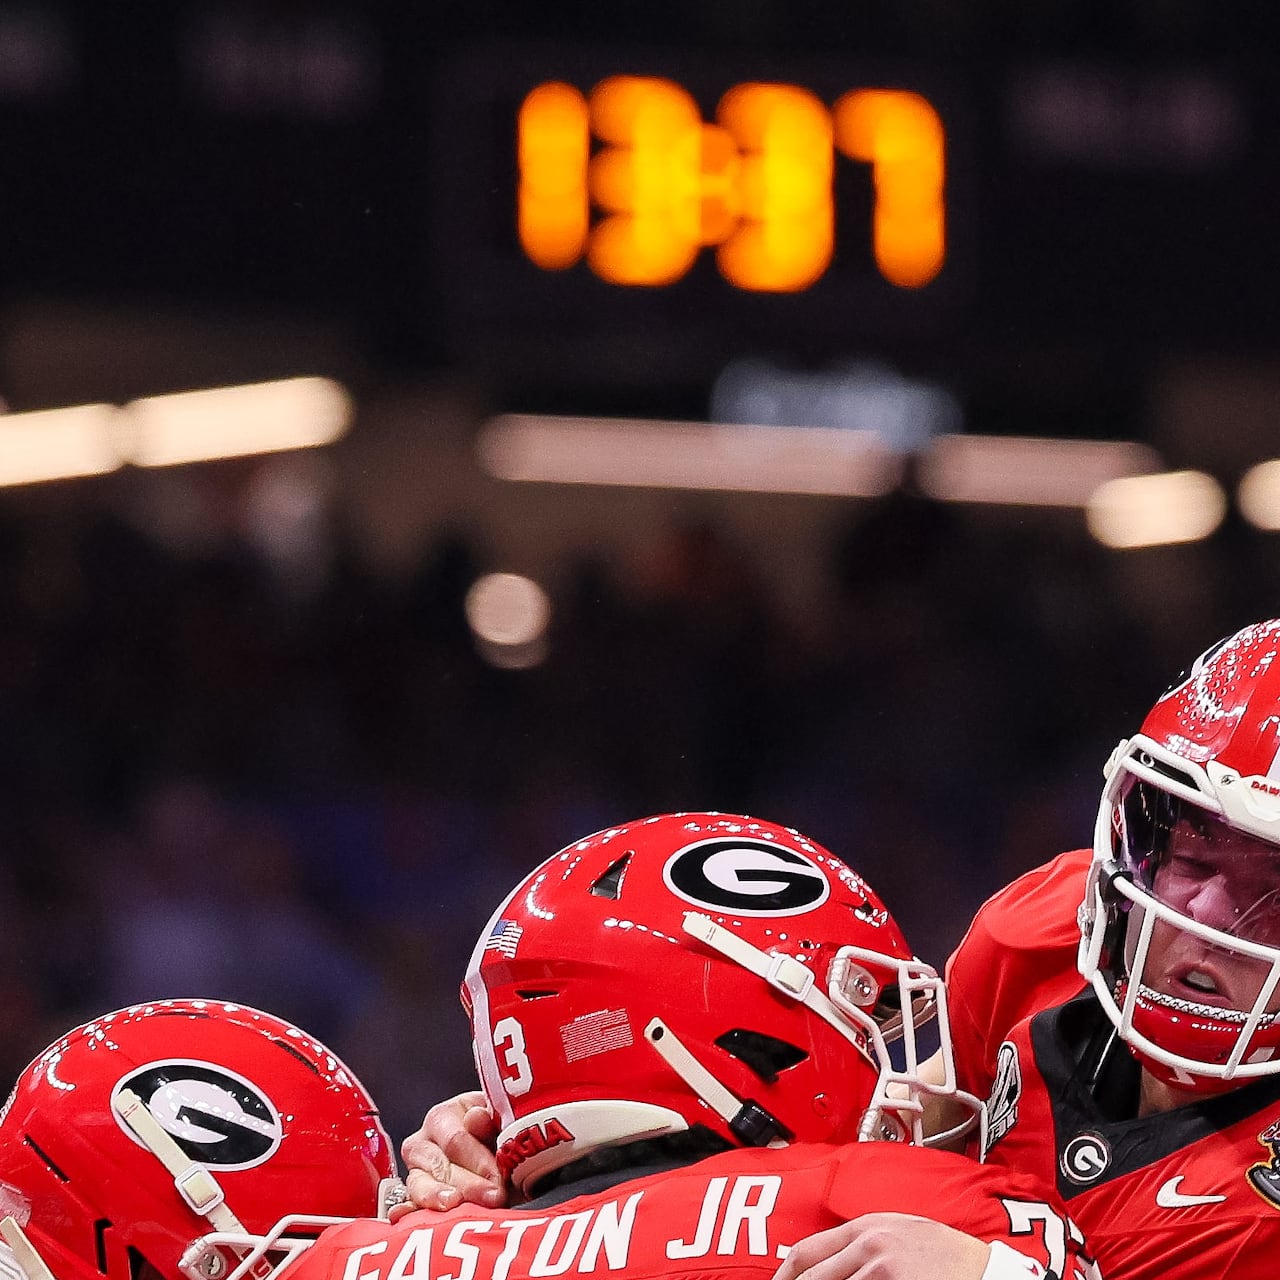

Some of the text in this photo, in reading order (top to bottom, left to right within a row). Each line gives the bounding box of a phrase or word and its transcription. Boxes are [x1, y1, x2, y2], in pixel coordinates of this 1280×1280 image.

[668, 839, 825, 912] G
[114, 1063, 279, 1166] G
[1065, 1137, 1108, 1179] G
